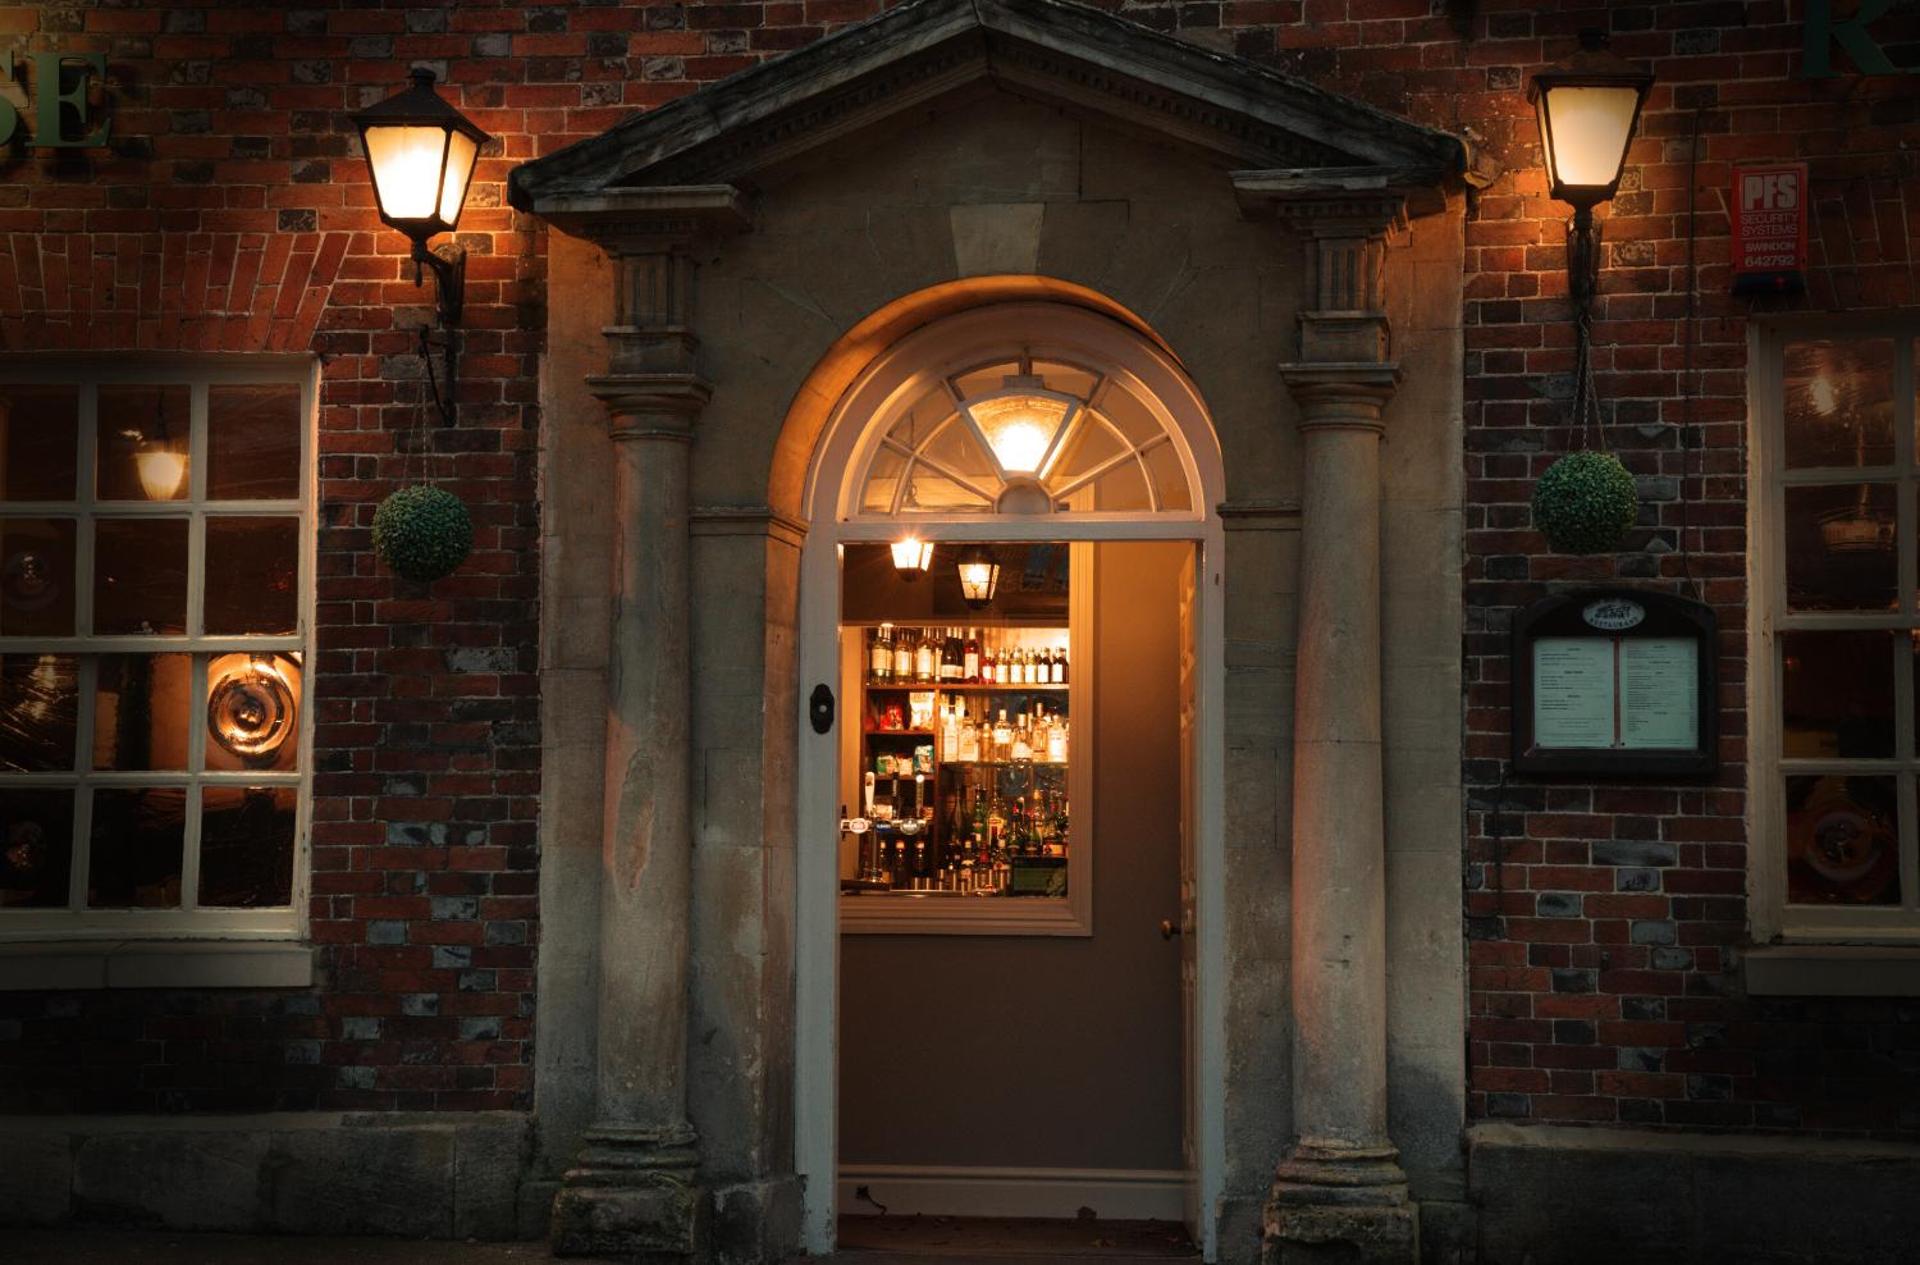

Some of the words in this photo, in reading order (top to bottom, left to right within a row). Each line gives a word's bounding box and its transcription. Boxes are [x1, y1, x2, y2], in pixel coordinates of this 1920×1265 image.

[1744, 174, 1798, 210] PFS
[1741, 214, 1799, 226] SECURITY
[1742, 225, 1798, 237] SYSTEMS
[1744, 241, 1796, 253] SWINDON
[1744, 255, 1795, 267] 642792
